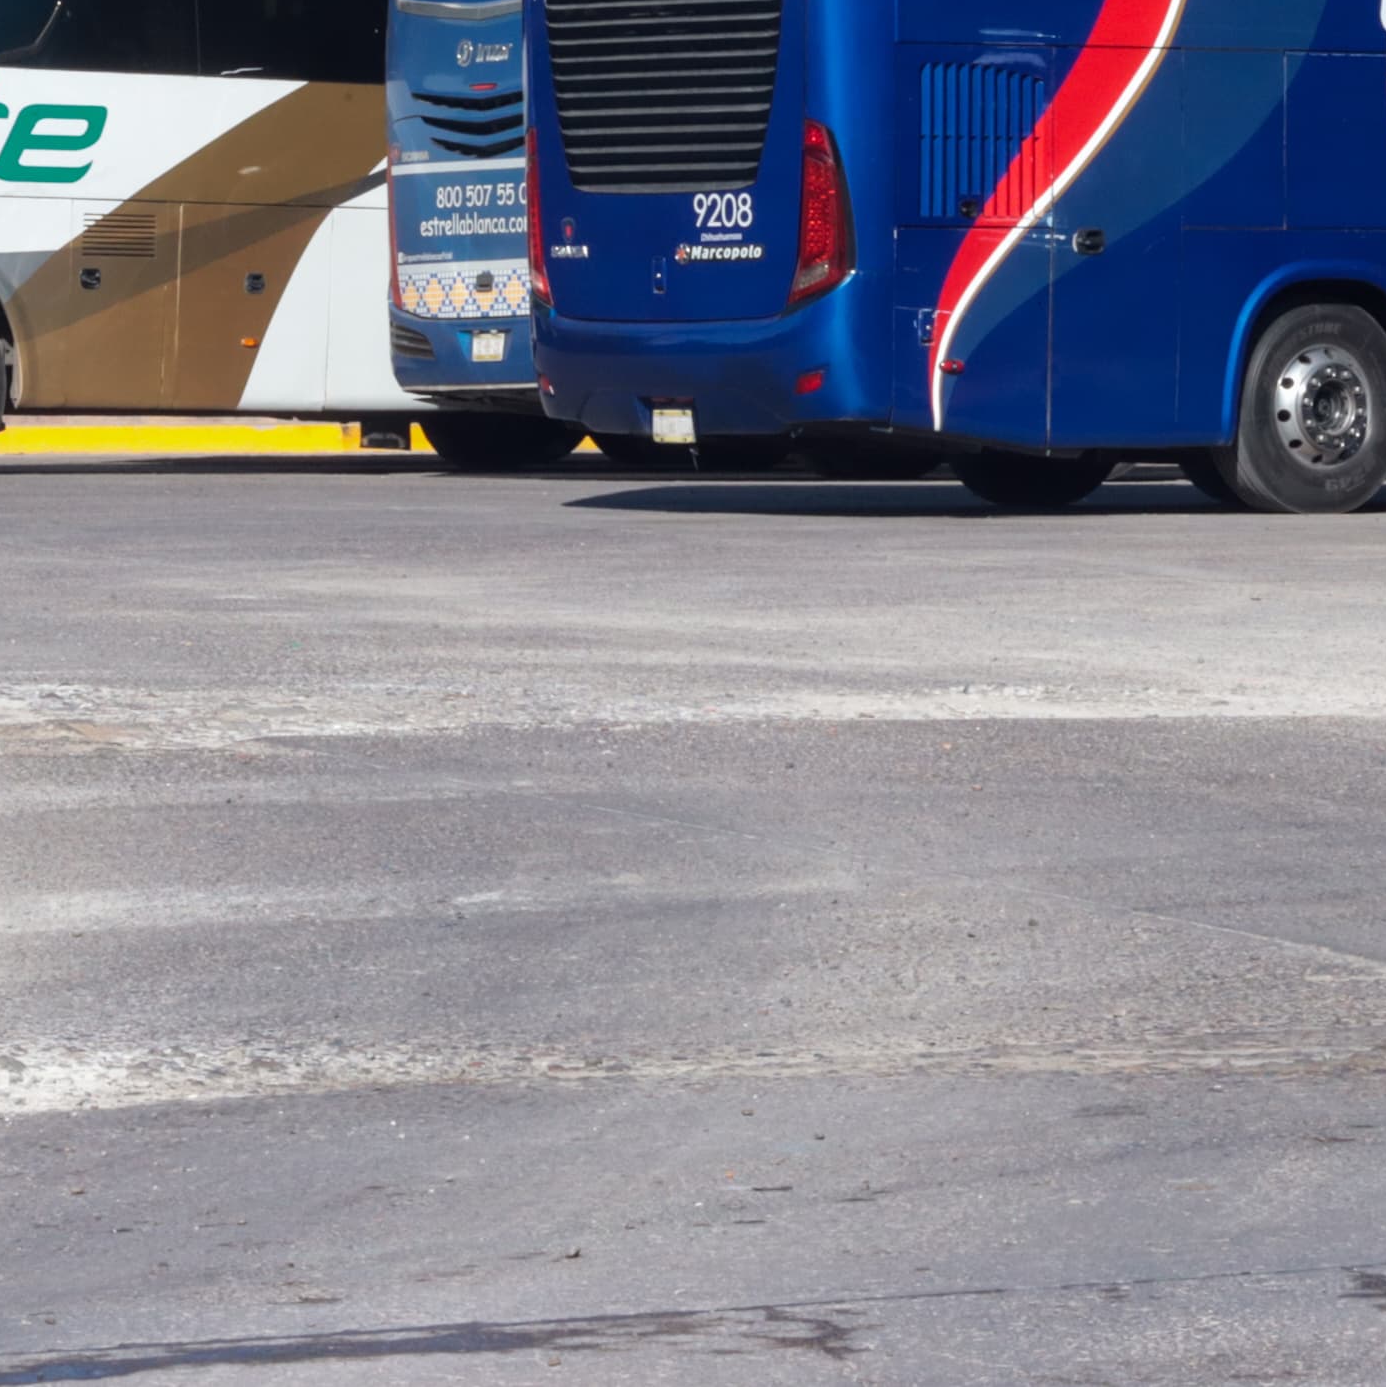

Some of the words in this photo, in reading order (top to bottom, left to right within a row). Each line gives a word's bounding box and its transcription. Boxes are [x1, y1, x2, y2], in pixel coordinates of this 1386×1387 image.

[436, 185, 462, 208] 800
[465, 184, 493, 207] 507
[496, 182, 515, 206] 55
[693, 192, 753, 228] 9208
[691, 244, 762, 260] Marcopolo
